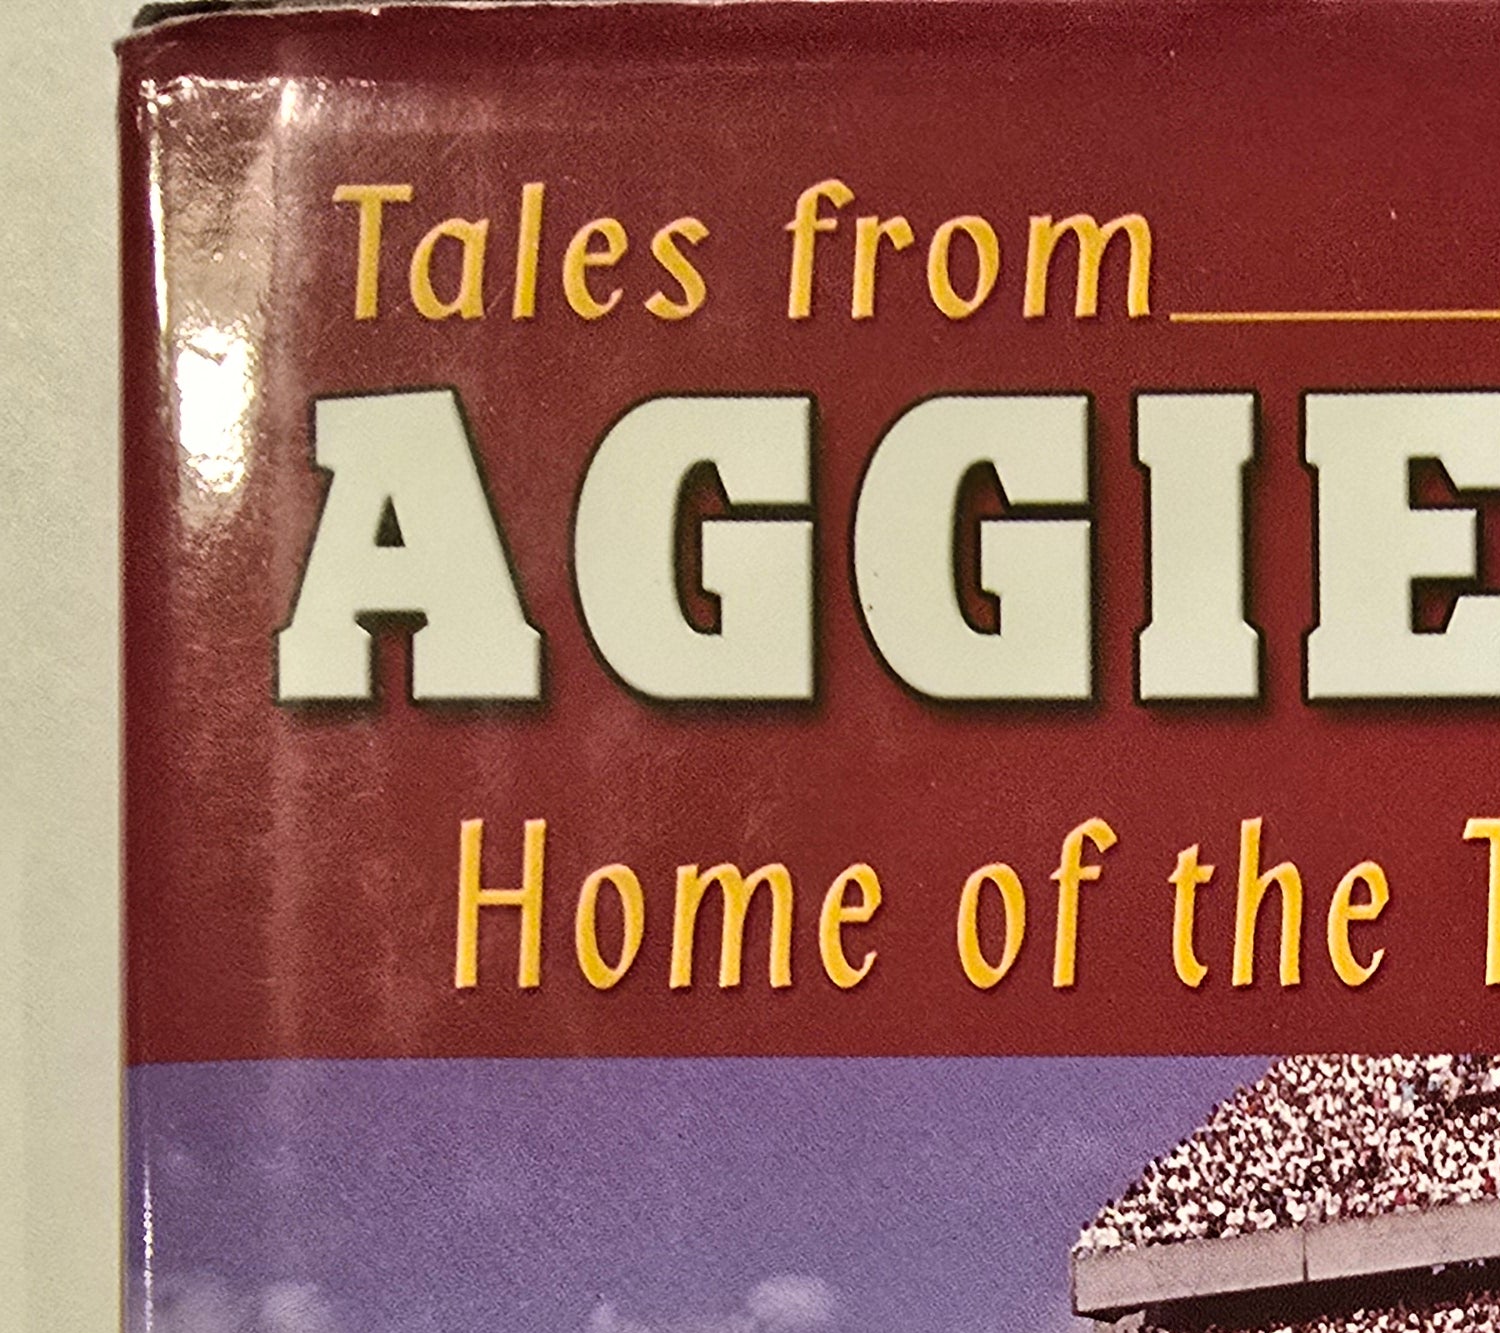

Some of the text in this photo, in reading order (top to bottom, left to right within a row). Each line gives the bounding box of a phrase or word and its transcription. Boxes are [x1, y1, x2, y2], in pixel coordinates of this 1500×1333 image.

[331, 178, 1153, 321] Tales from
[453, 817, 883, 990] Home
[956, 816, 1118, 990] of
[1166, 815, 1390, 990] the
